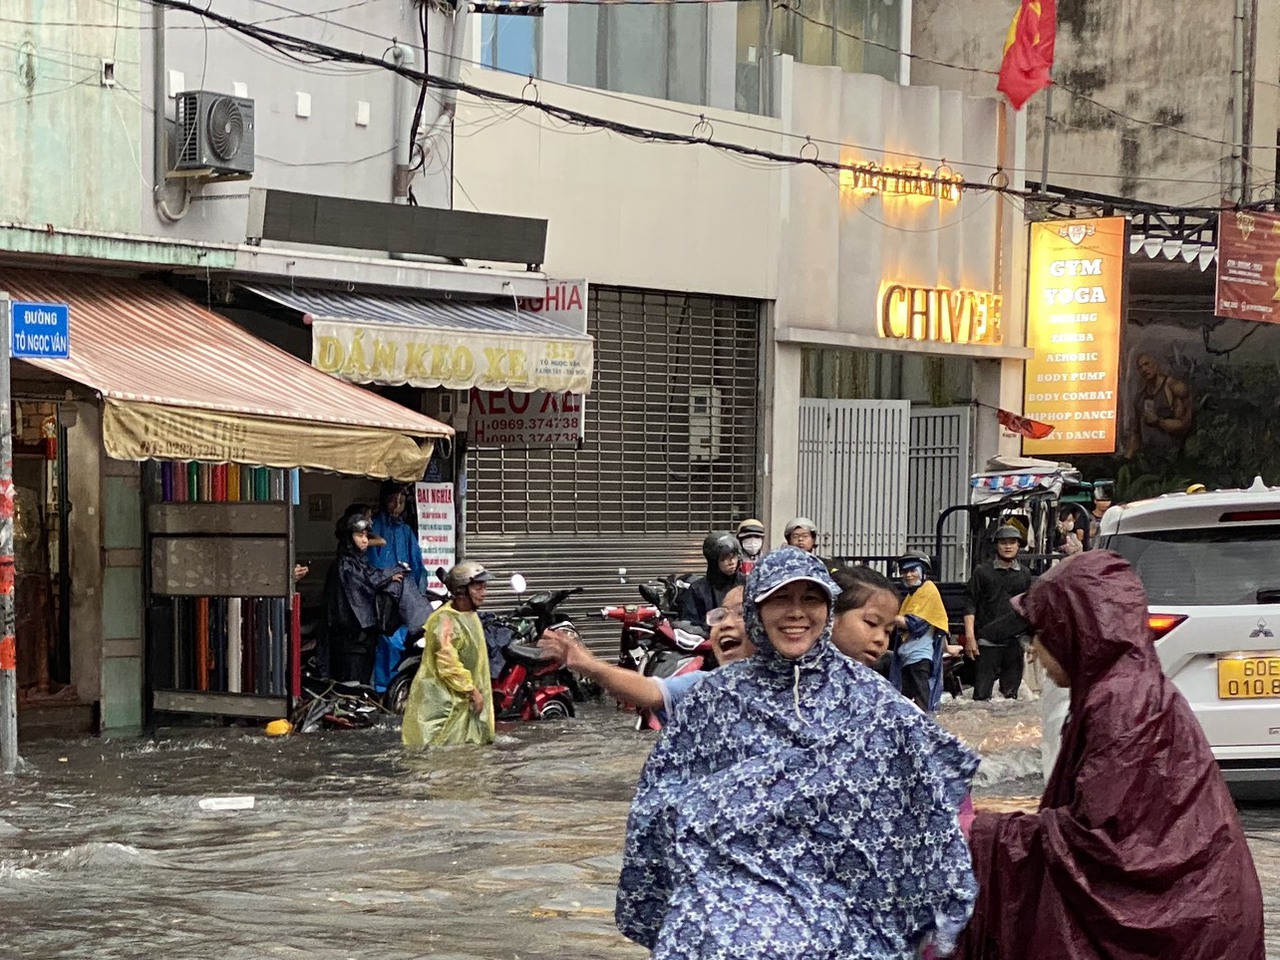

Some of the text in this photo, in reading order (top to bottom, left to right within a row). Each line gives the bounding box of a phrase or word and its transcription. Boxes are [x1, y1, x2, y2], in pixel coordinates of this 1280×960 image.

[1049, 257, 1104, 277] GYM
[1042, 285, 1108, 305] YOGA
[24, 309, 58, 326] ĐƯỜNG
[15, 331, 67, 355] TÔ NGỌC VÂN
[319, 328, 399, 377] DÁN
[404, 342, 476, 382] KEO
[484, 346, 529, 384] XE
[1045, 351, 1100, 363] AEROBIC
[1036, 371, 1108, 383] BODY PUMP
[1062, 390, 1114, 401] COMBAT
[1074, 410, 1115, 421] DANCE
[1066, 430, 1107, 441] DANCE
